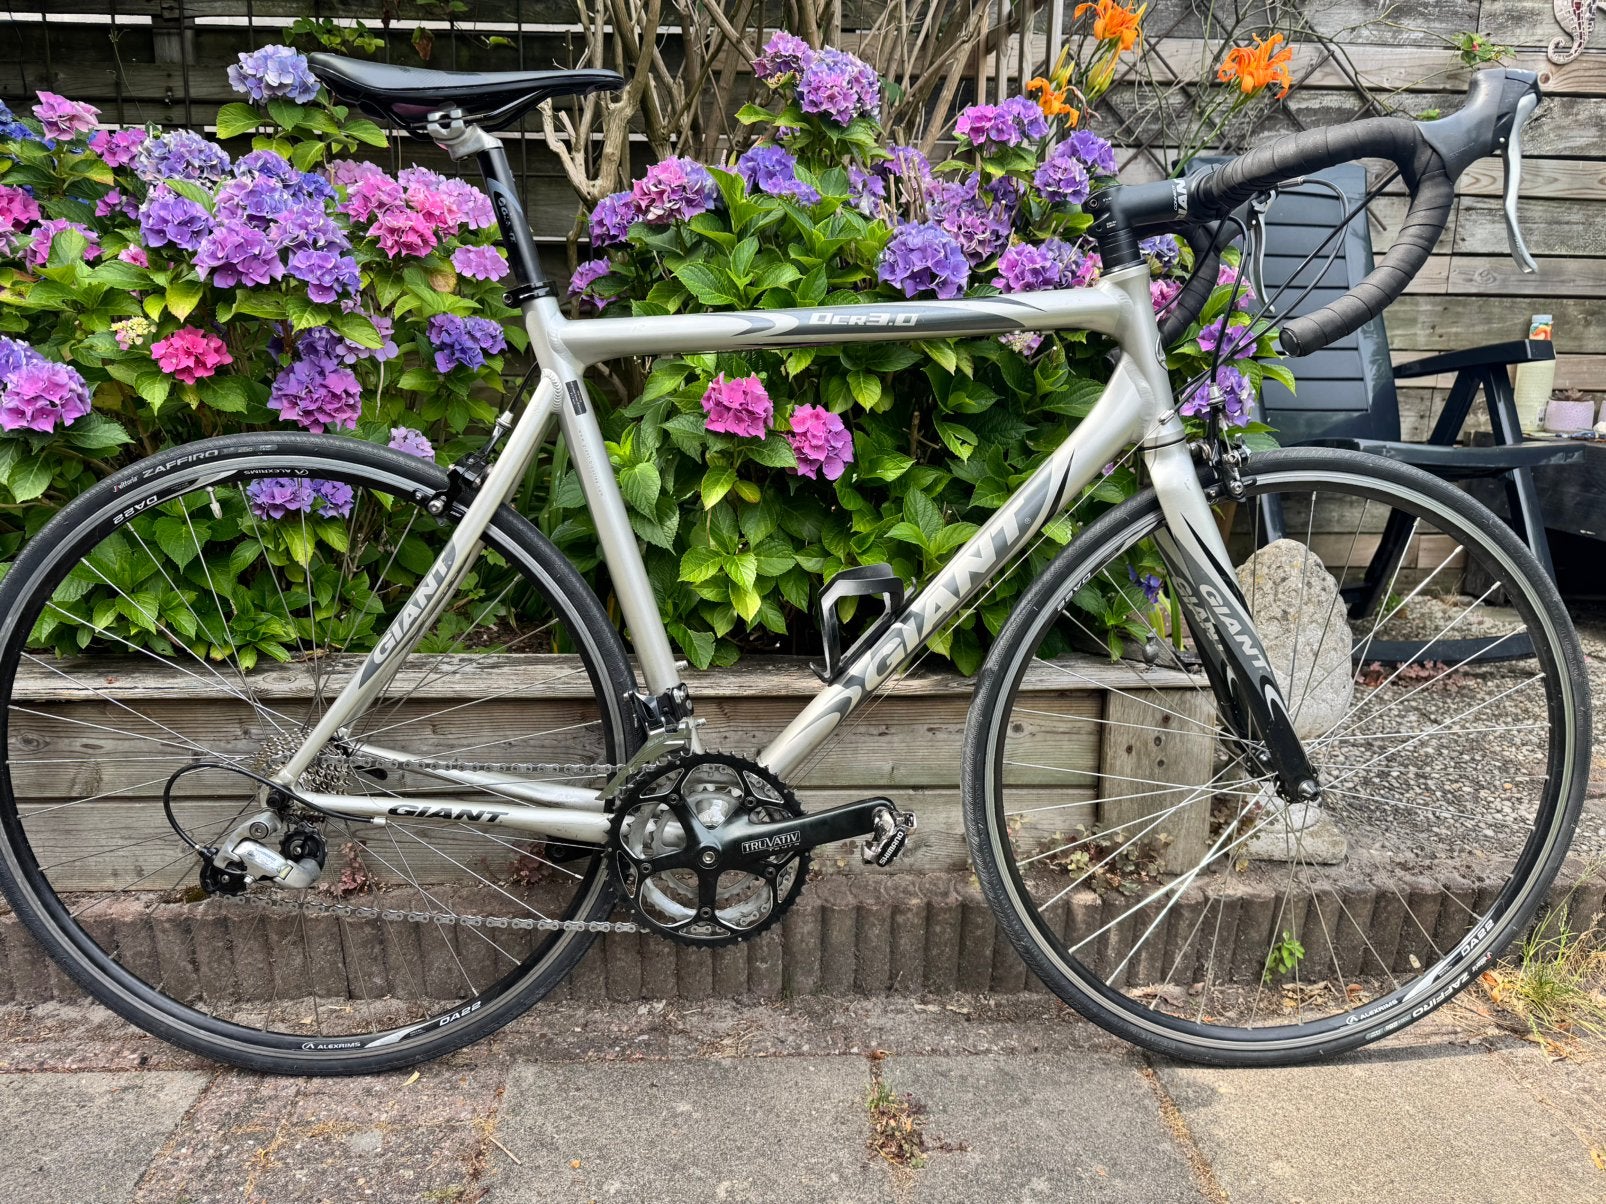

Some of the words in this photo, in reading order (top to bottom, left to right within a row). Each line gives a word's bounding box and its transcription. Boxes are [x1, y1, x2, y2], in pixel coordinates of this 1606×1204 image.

[143, 449, 219, 479] ZAFFIRO
[112, 495, 158, 525] DA22
[373, 551, 449, 664] GIANT
[865, 496, 1024, 691] GIANT
[1199, 584, 1272, 672] GIANT
[388, 804, 509, 823] GIANT
[743, 832, 800, 853] TRUVATIV
[879, 831, 904, 865] SHIMANO
[1460, 918, 1495, 957] DA22
[1360, 999, 1399, 1020] ALEXRIMS
[1412, 971, 1470, 1018] ZAFFIRO
[439, 1000, 482, 1027] DA22
[317, 1041, 361, 1050] ALEXRIMS
